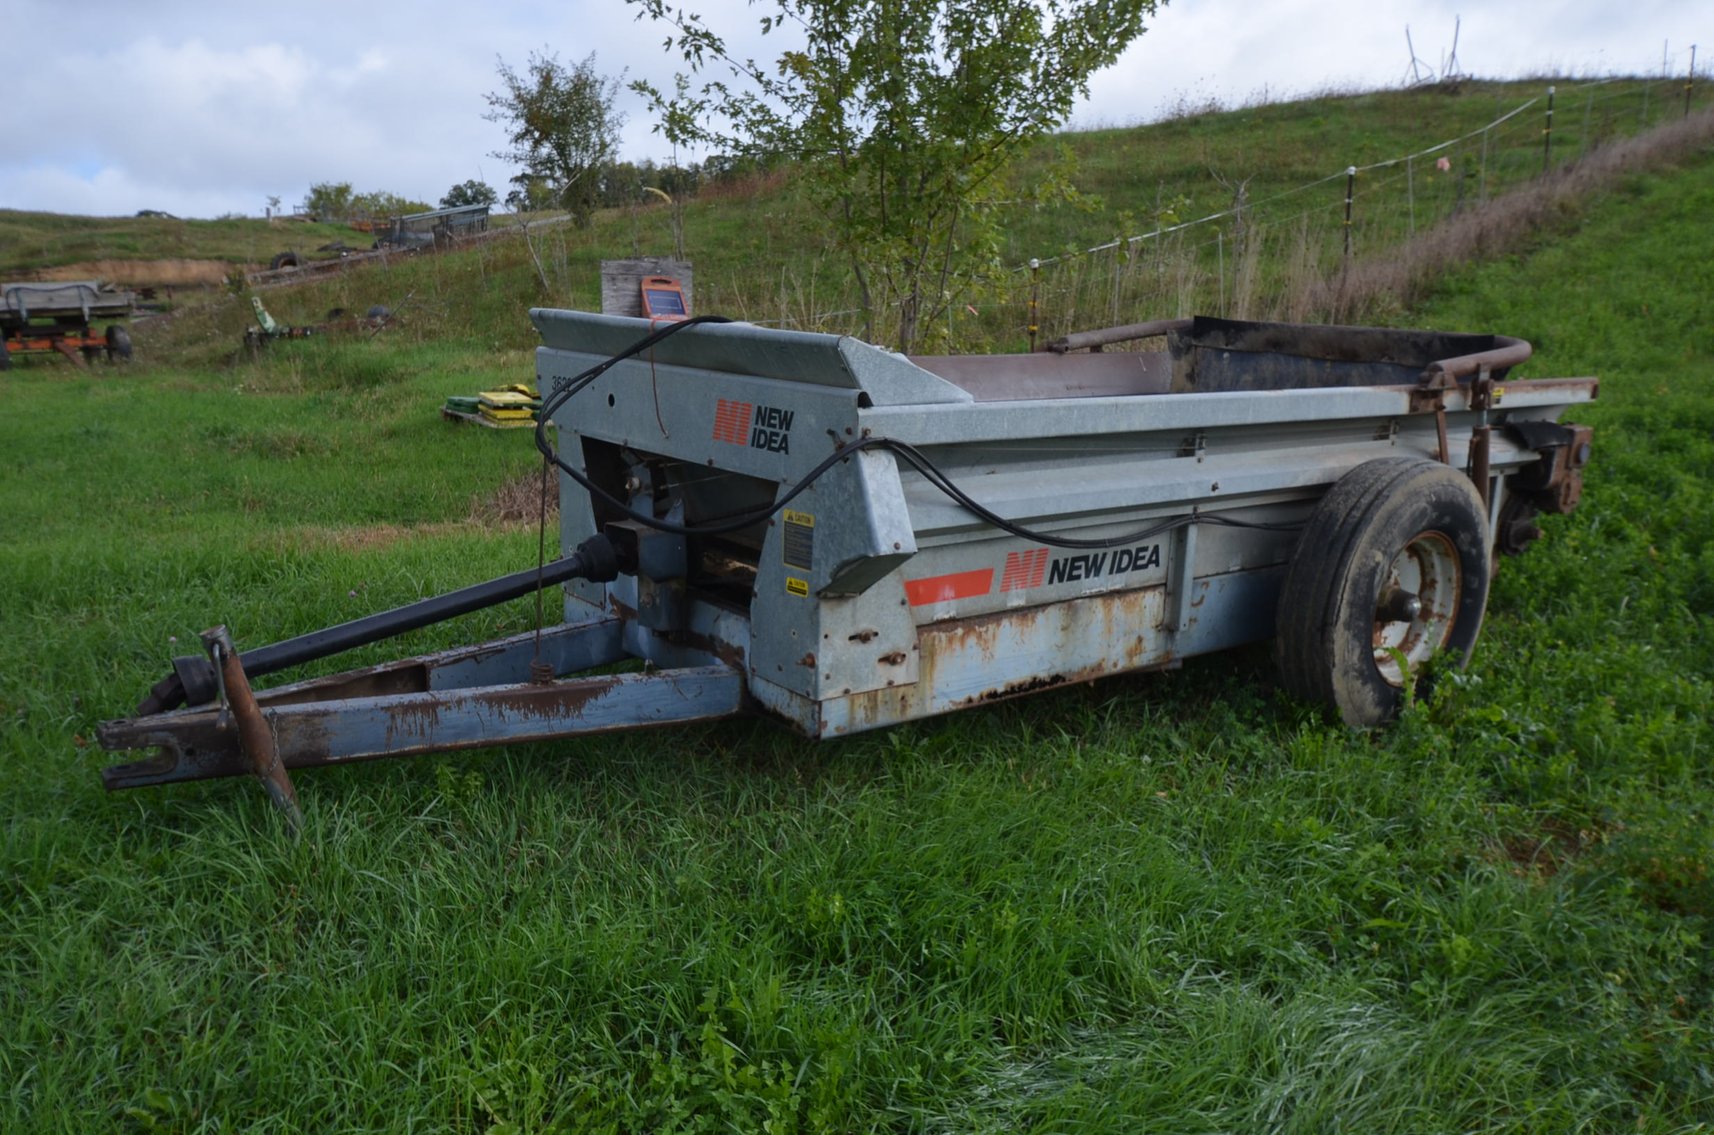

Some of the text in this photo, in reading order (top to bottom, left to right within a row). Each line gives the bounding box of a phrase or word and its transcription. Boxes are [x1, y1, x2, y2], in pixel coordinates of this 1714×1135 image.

[755, 405, 795, 432] NEW
[751, 427, 789, 455] IDEA
[1048, 552, 1107, 585] NEW
[1108, 544, 1160, 575] IDEA
